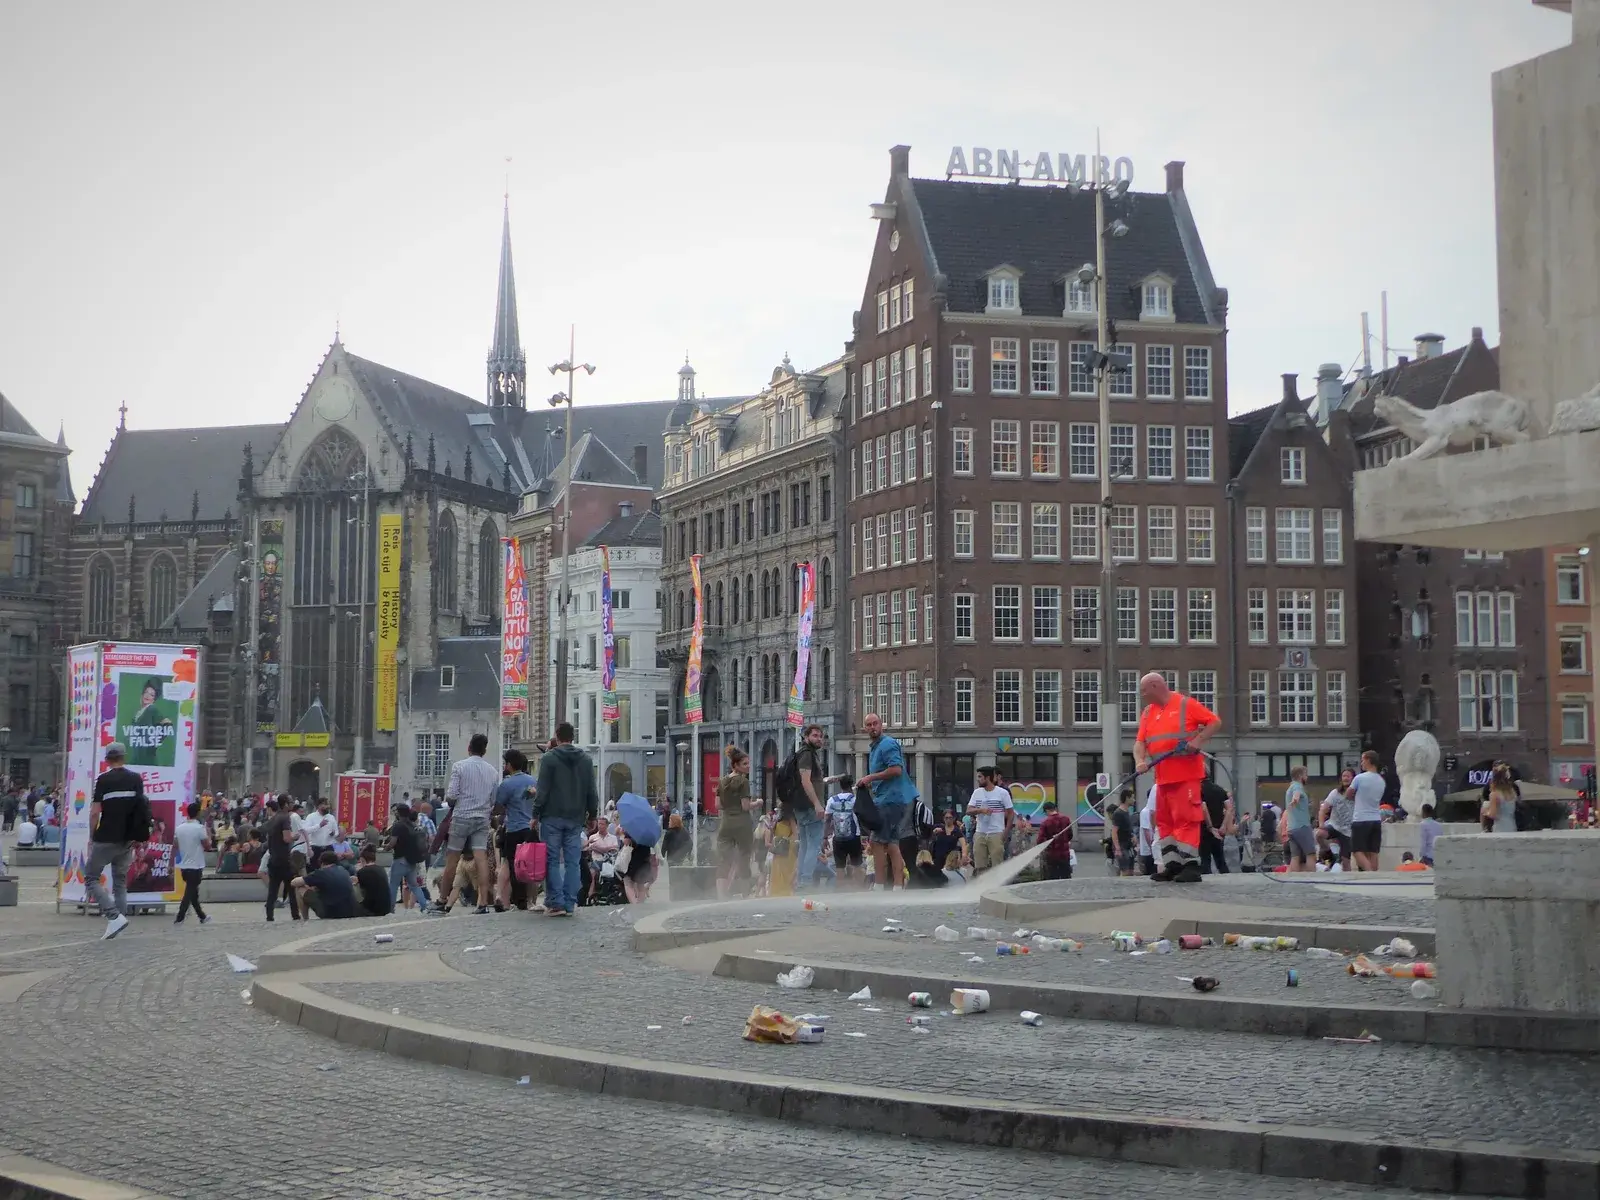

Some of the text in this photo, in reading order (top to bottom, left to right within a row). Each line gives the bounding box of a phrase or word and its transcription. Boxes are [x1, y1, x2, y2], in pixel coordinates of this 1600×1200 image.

[381, 529, 391, 574] in de tijd
[392, 528, 401, 550] Reis
[380, 601, 390, 640] Royalty
[389, 590, 399, 629] History
[122, 725, 175, 736] VICTORIA
[129, 736, 163, 747] FALSE
